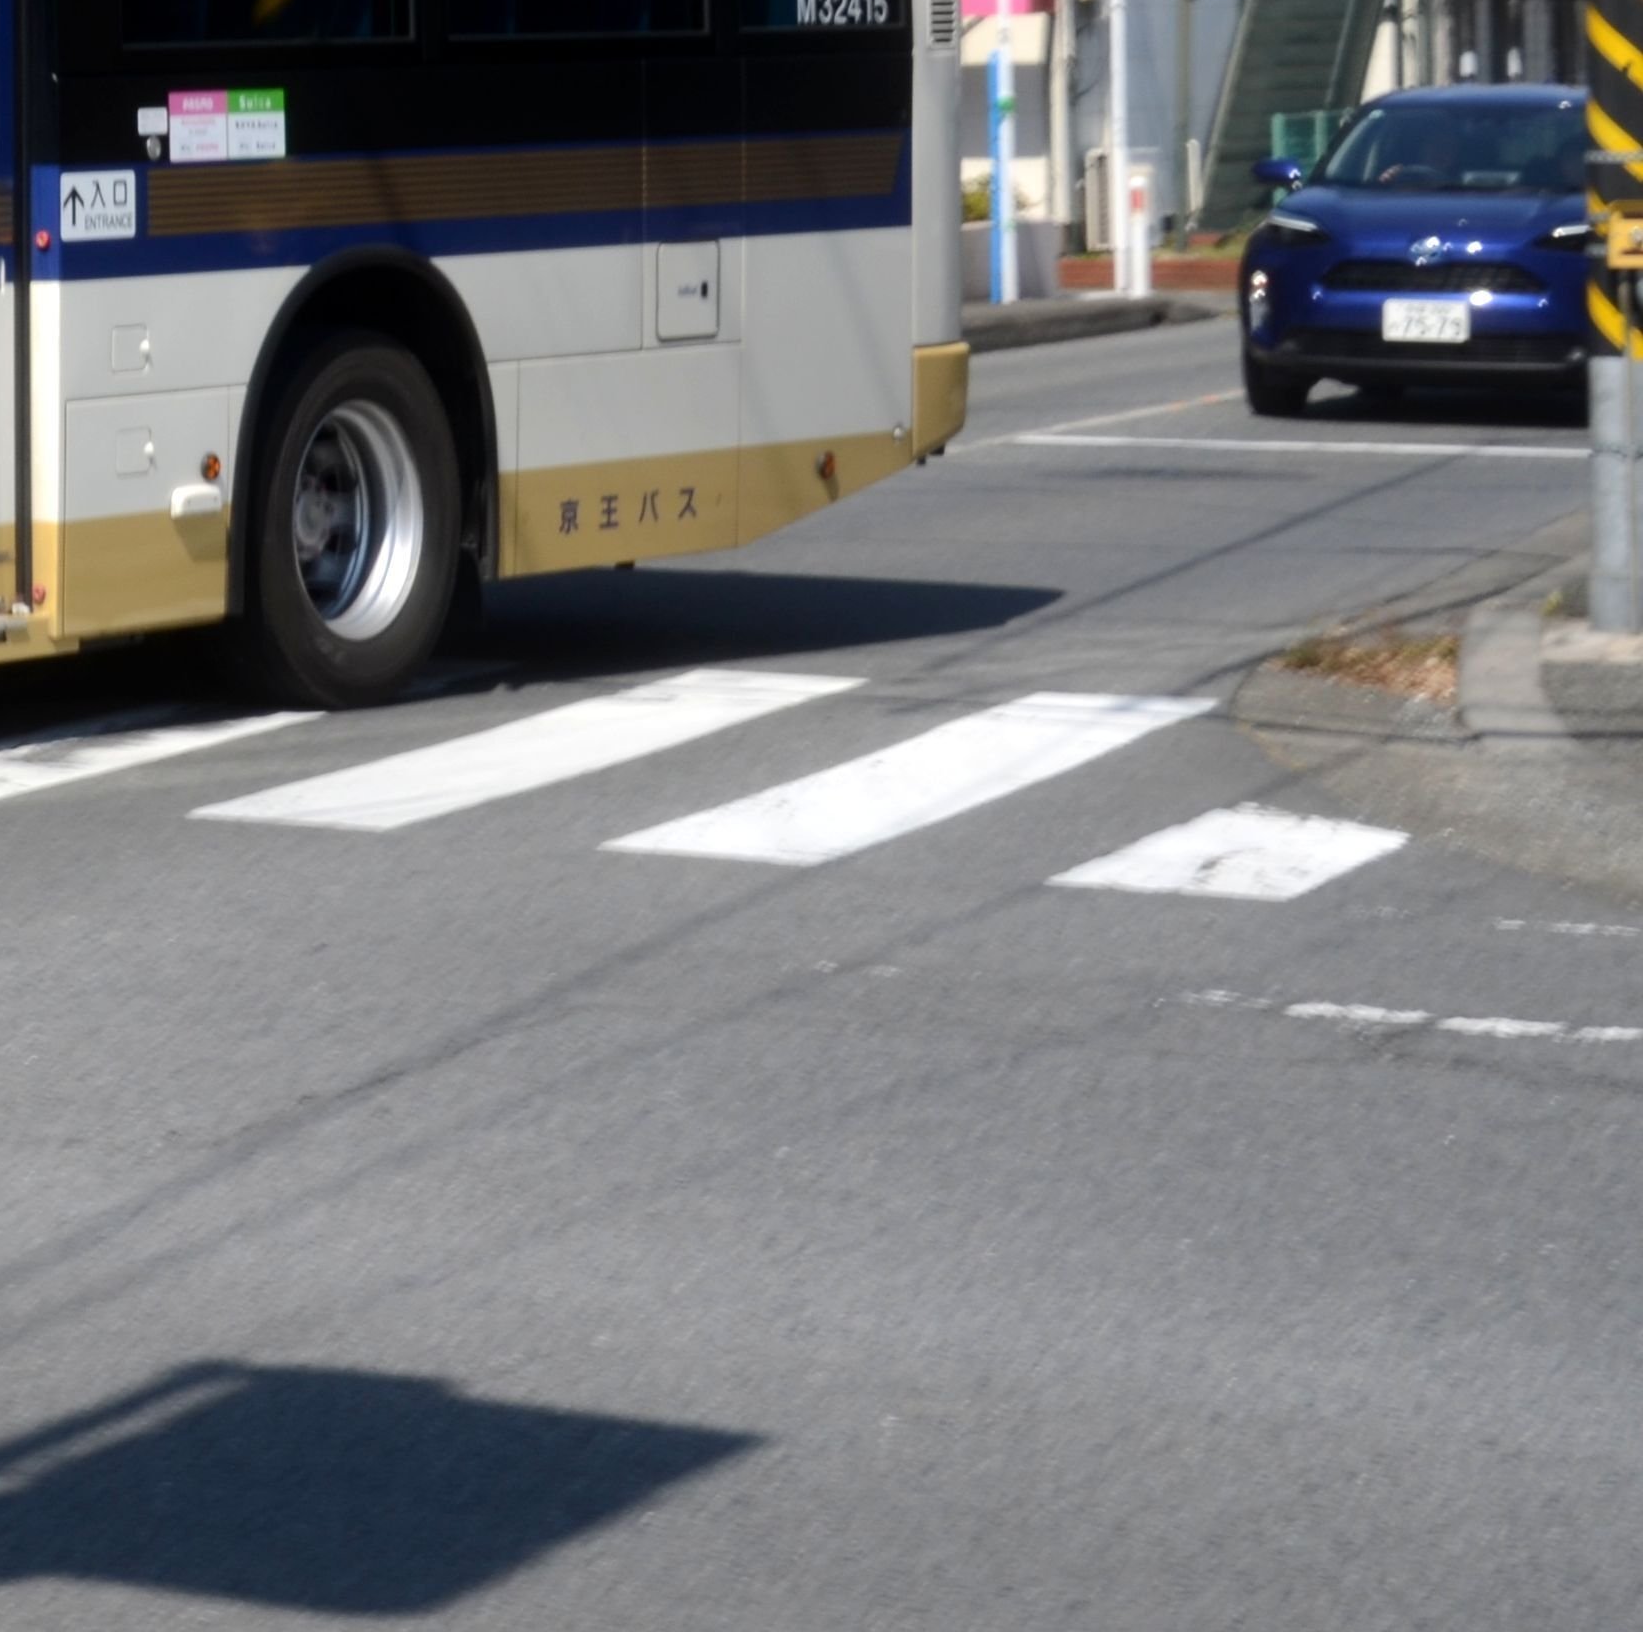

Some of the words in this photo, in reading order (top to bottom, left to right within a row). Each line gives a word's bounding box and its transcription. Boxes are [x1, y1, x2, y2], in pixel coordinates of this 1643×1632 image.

[238, 94, 272, 109] Suica
[90, 179, 128, 209] 入口
[84, 213, 132, 231] ENTRANCE
[558, 487, 698, 535] 京王バス
